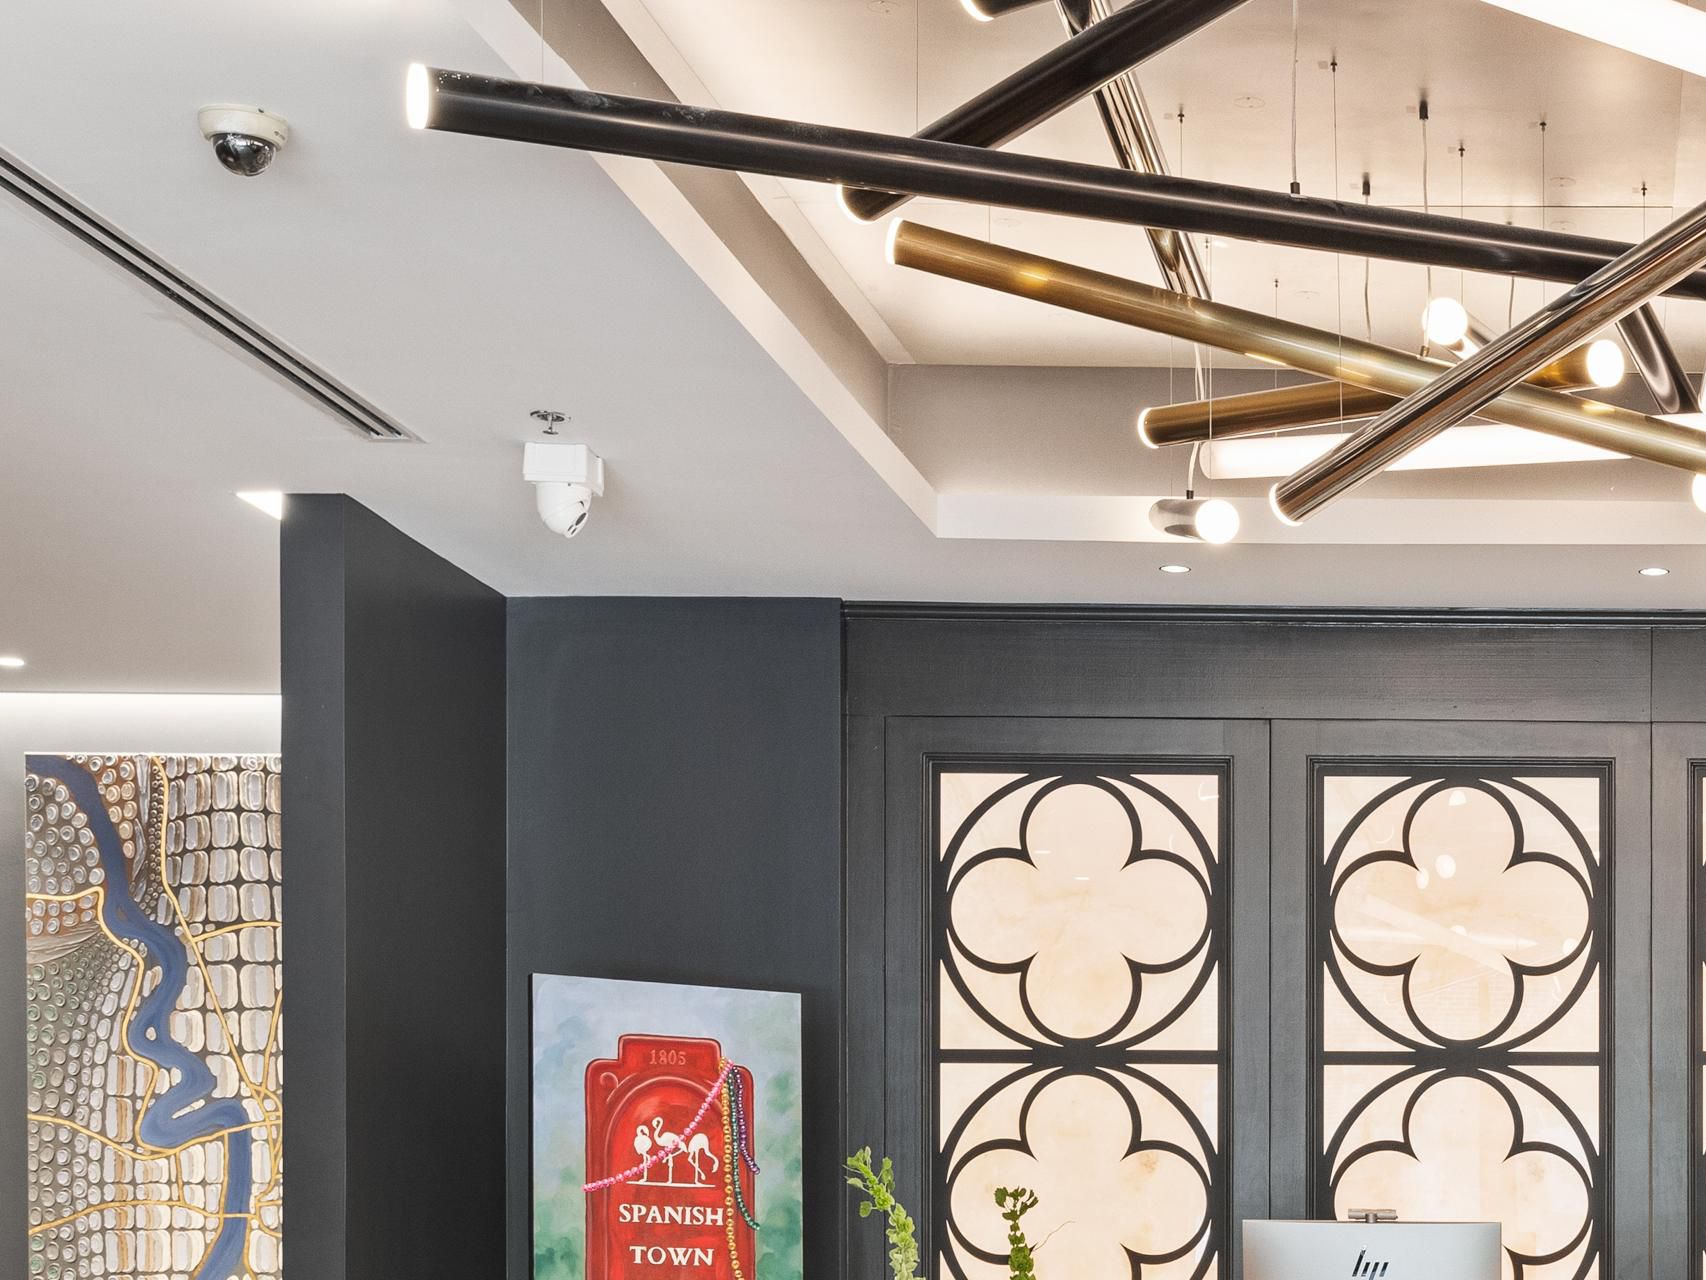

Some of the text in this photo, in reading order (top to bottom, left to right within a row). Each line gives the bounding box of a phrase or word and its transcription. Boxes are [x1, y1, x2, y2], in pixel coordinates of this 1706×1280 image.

[650, 1049, 687, 1066] 1805
[618, 1203, 725, 1226] SPANISH
[629, 1245, 715, 1267] TOWN
